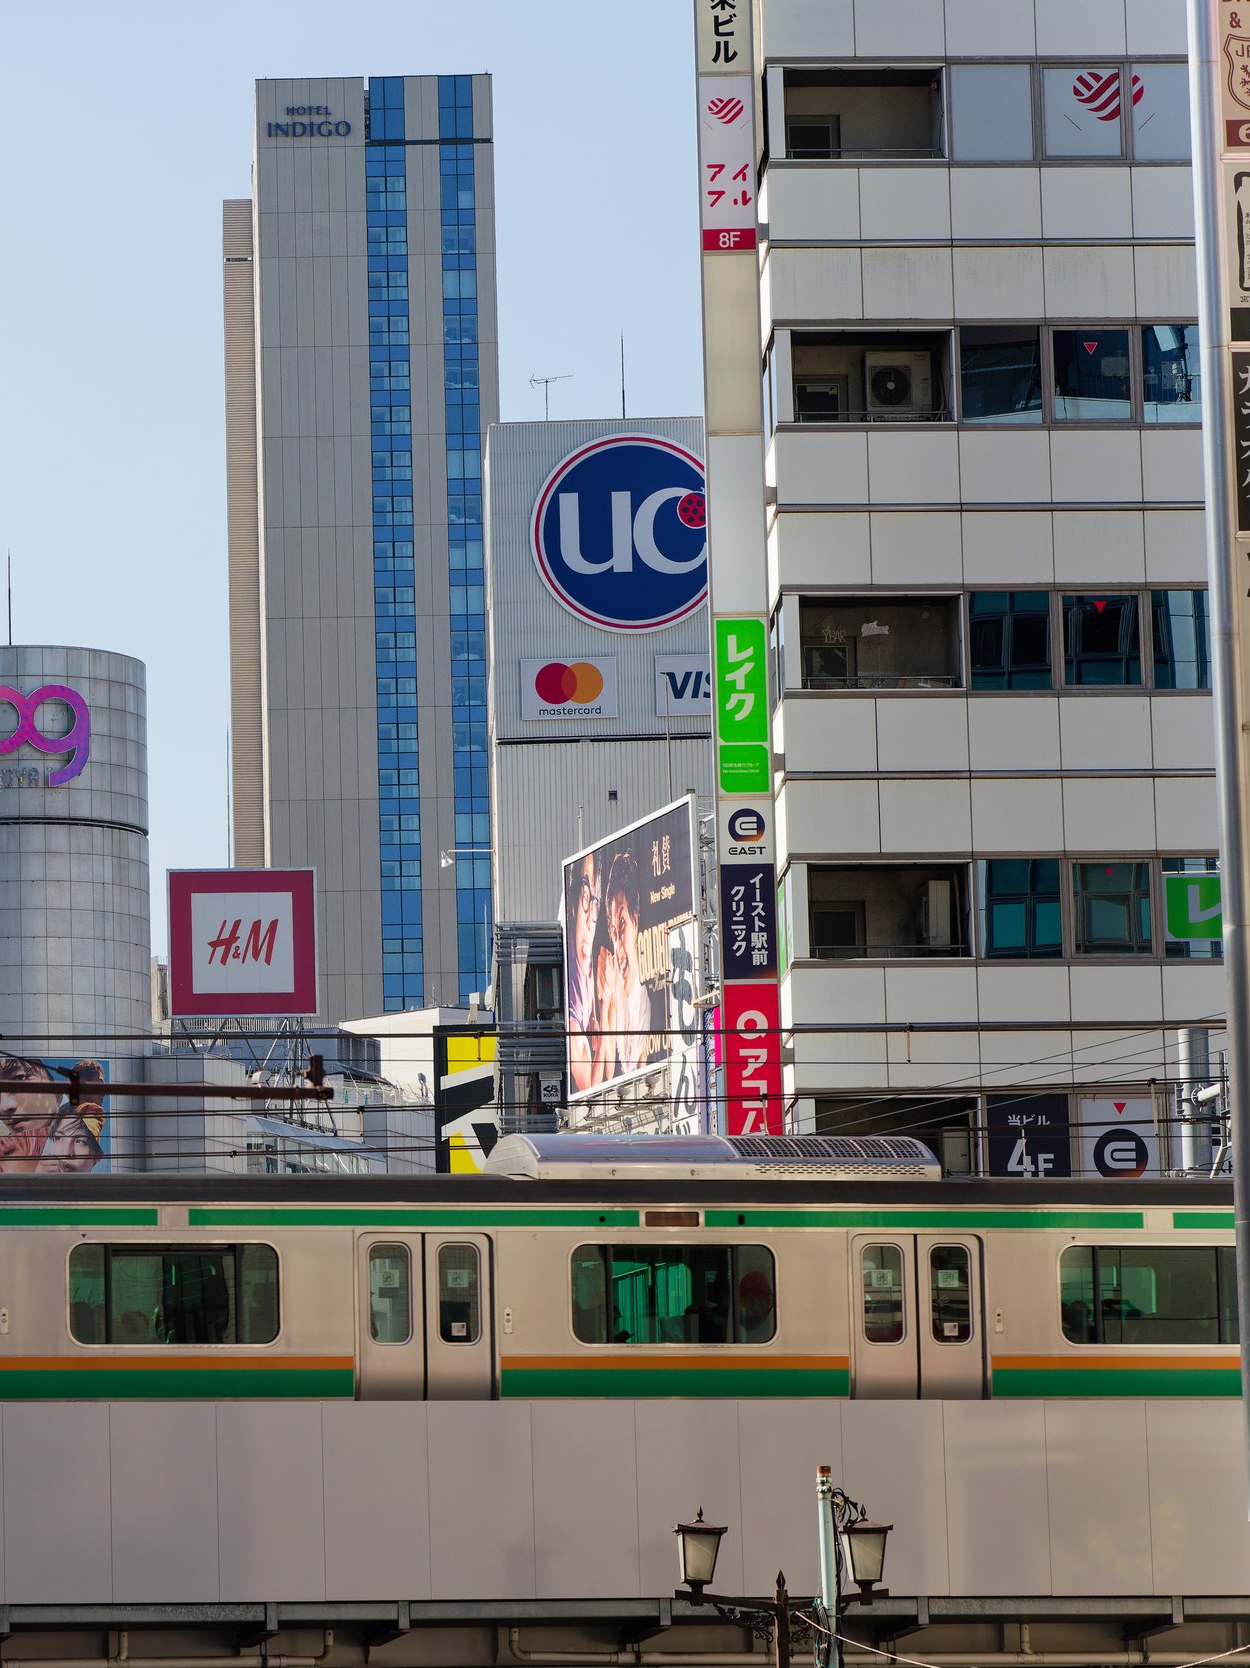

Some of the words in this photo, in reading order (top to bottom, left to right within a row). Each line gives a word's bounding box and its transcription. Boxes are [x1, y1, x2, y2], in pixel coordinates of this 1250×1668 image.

[286, 105, 332, 116] HOTEL
[267, 121, 352, 138] INDIGO
[719, 232, 741, 249] 8F
[725, 634, 755, 721] レイク
[539, 705, 601, 716] mastercard
[728, 846, 767, 856] EAST
[730, 885, 747, 958] クリニック
[749, 872, 769, 967] イースト駅前
[207, 918, 279, 967] H&M
[1007, 1113, 1051, 1126] 当ビル
[1007, 1138, 1055, 1178] 4F
